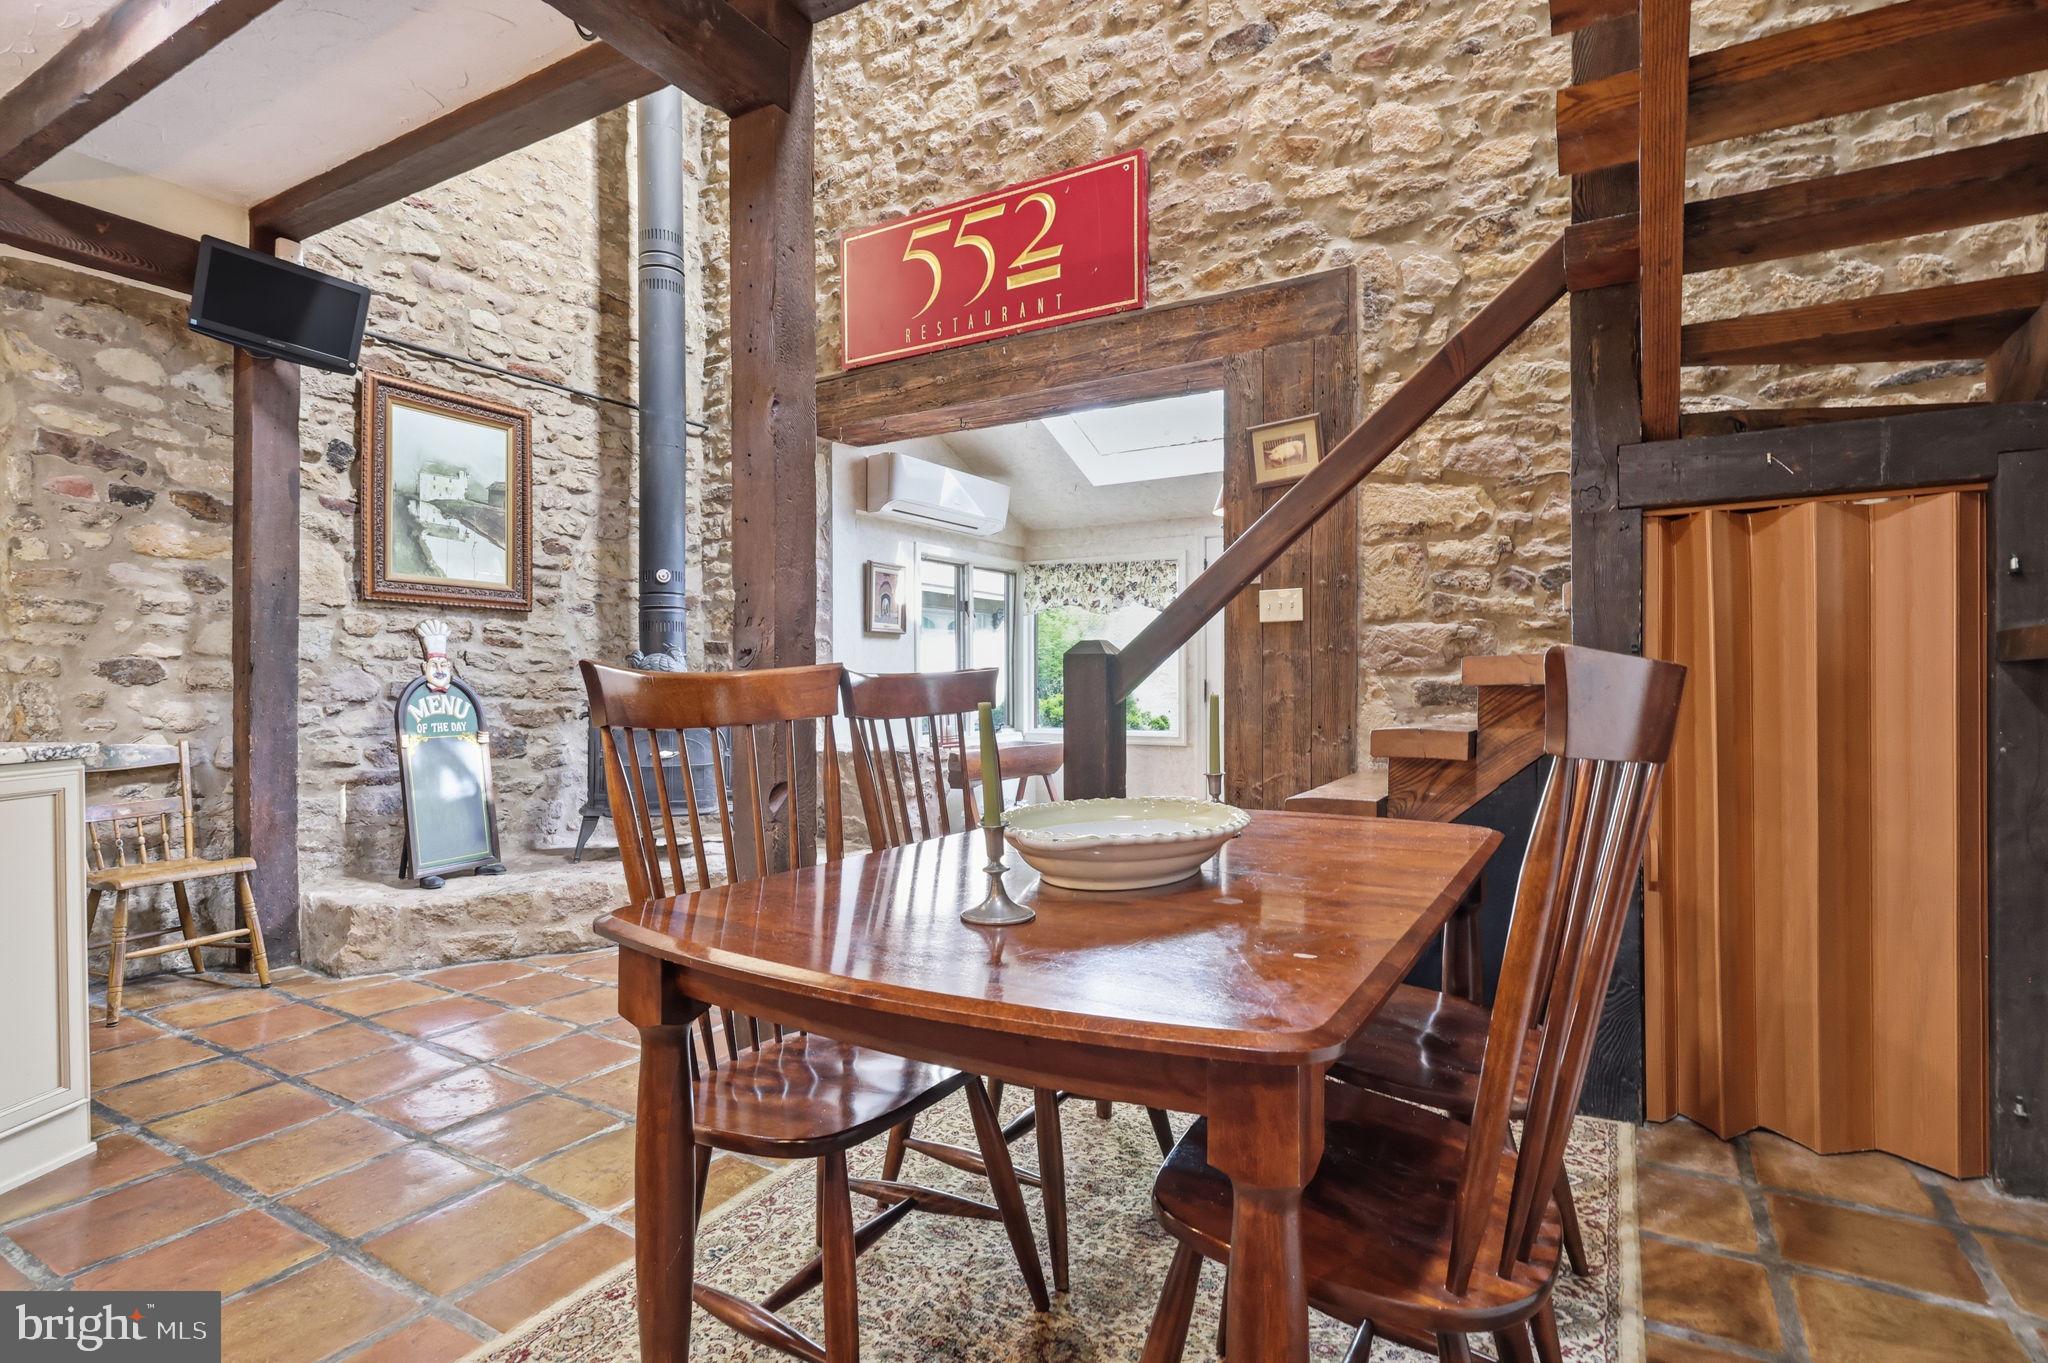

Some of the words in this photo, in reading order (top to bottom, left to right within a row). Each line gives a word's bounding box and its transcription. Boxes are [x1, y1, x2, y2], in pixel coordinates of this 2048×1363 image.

[902, 192, 1063, 319] 552
[905, 293, 1063, 343] RESTAURANT
[408, 695, 471, 723] MENU
[416, 723, 428, 734] OF
[431, 722, 449, 733] THE
[451, 721, 467, 732] DAY
